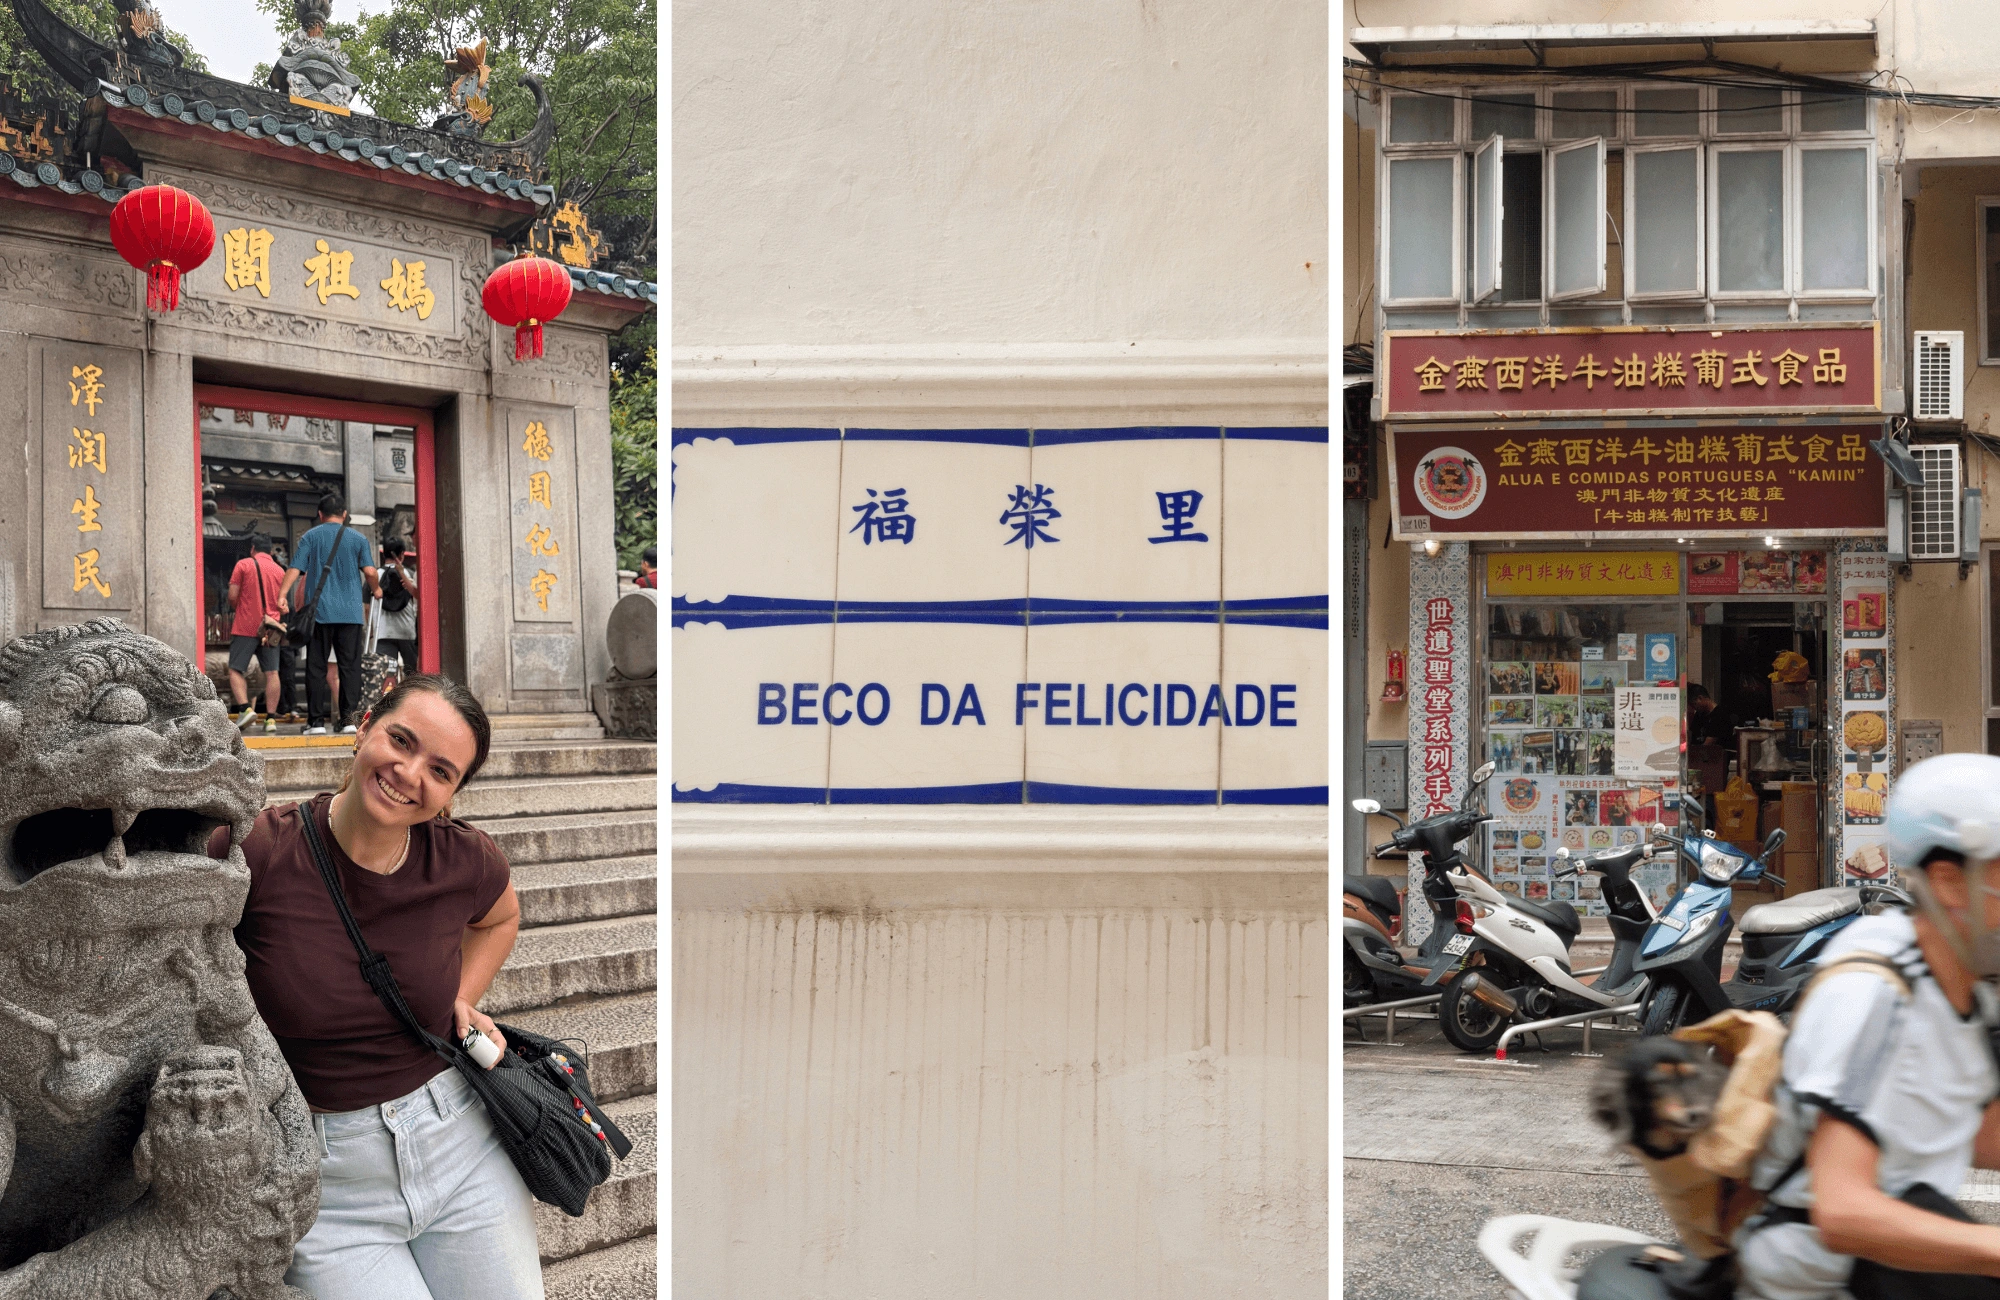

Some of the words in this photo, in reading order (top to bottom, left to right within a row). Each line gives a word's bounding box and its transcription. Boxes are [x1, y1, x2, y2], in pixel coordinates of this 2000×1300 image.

[1413, 347, 1847, 392] 金燕西洋牛油糕葡式食品
[1494, 434, 1866, 468] 金燕西洋牛油糕葡式食品
[1498, 473, 1544, 486] ALUA
[1551, 473, 1561, 485] E
[1569, 472, 1649, 485] COMIDAS
[1657, 470, 1777, 484] PORTUGUESA
[848, 484, 1209, 550] 福榮里
[1414, 519, 1428, 529] 105
[757, 683, 891, 727] BECO
[920, 683, 986, 726] DA
[1015, 683, 1298, 727] FELICIDADE
[1618, 691, 1645, 731] 非遺
